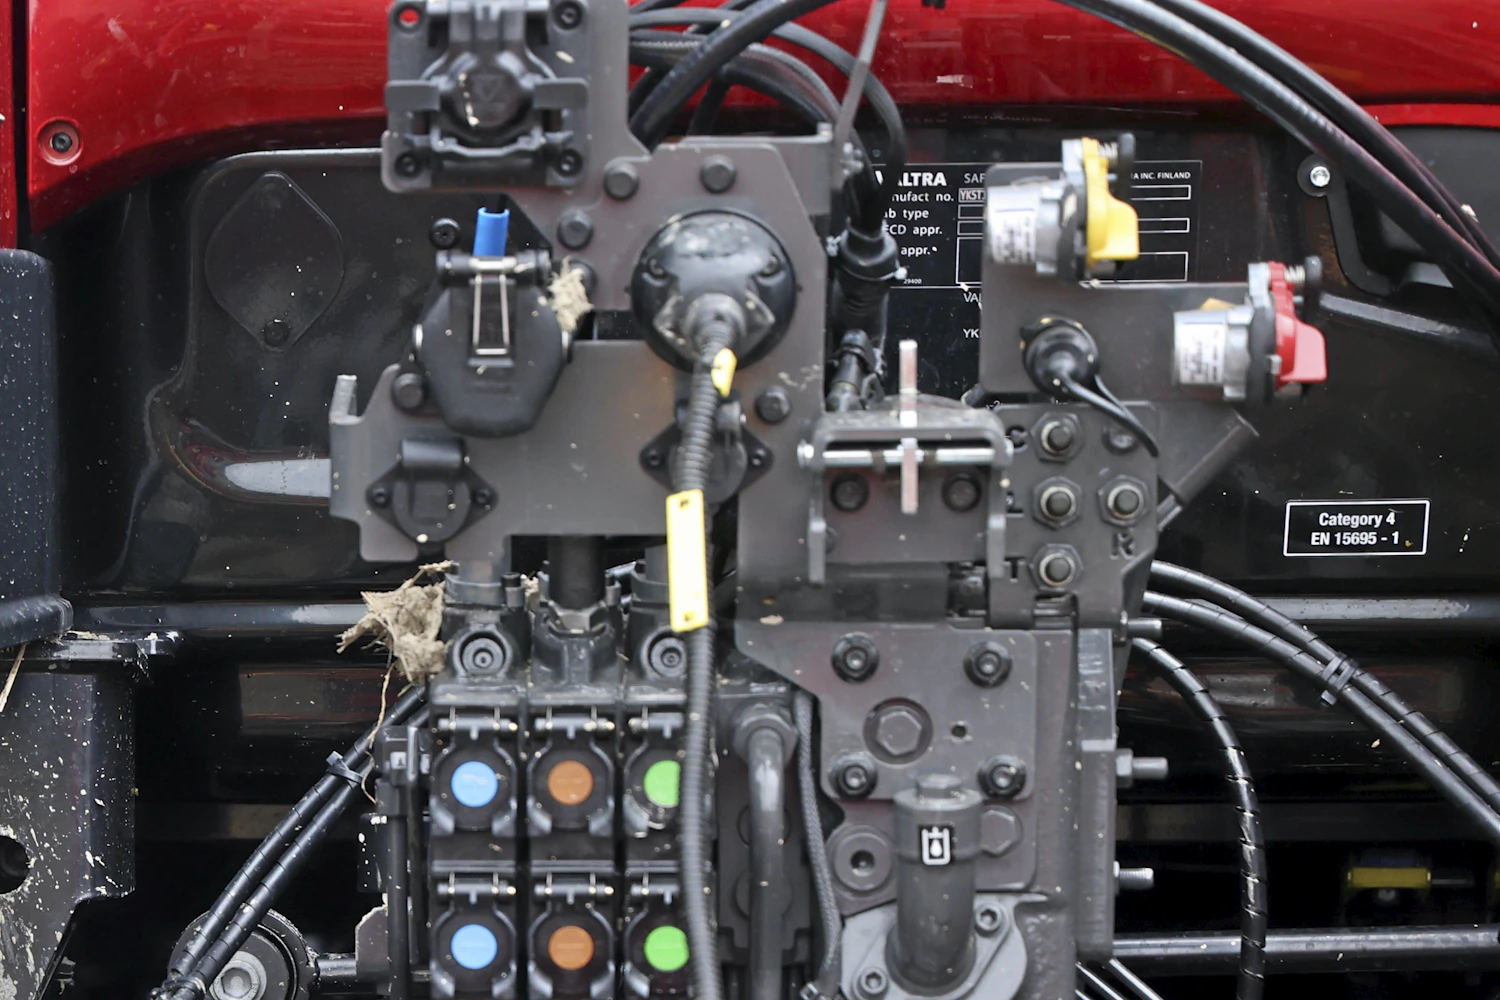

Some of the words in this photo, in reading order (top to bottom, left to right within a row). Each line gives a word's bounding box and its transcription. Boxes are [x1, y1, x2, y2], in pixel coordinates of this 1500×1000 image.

[875, 171, 947, 186] VLTRA
[1157, 171, 1191, 179] FINLAND
[936, 193, 954, 201] no.
[903, 209, 929, 220] type
[913, 225, 942, 236] appr.
[901, 246, 930, 257] appr.
[963, 328, 981, 338] YK
[1319, 512, 1383, 529] Category
[1386, 511, 1396, 525] 4
[1311, 532, 1330, 546] EN
[1334, 531, 1377, 546] 15695
[1391, 531, 1399, 544] 1
